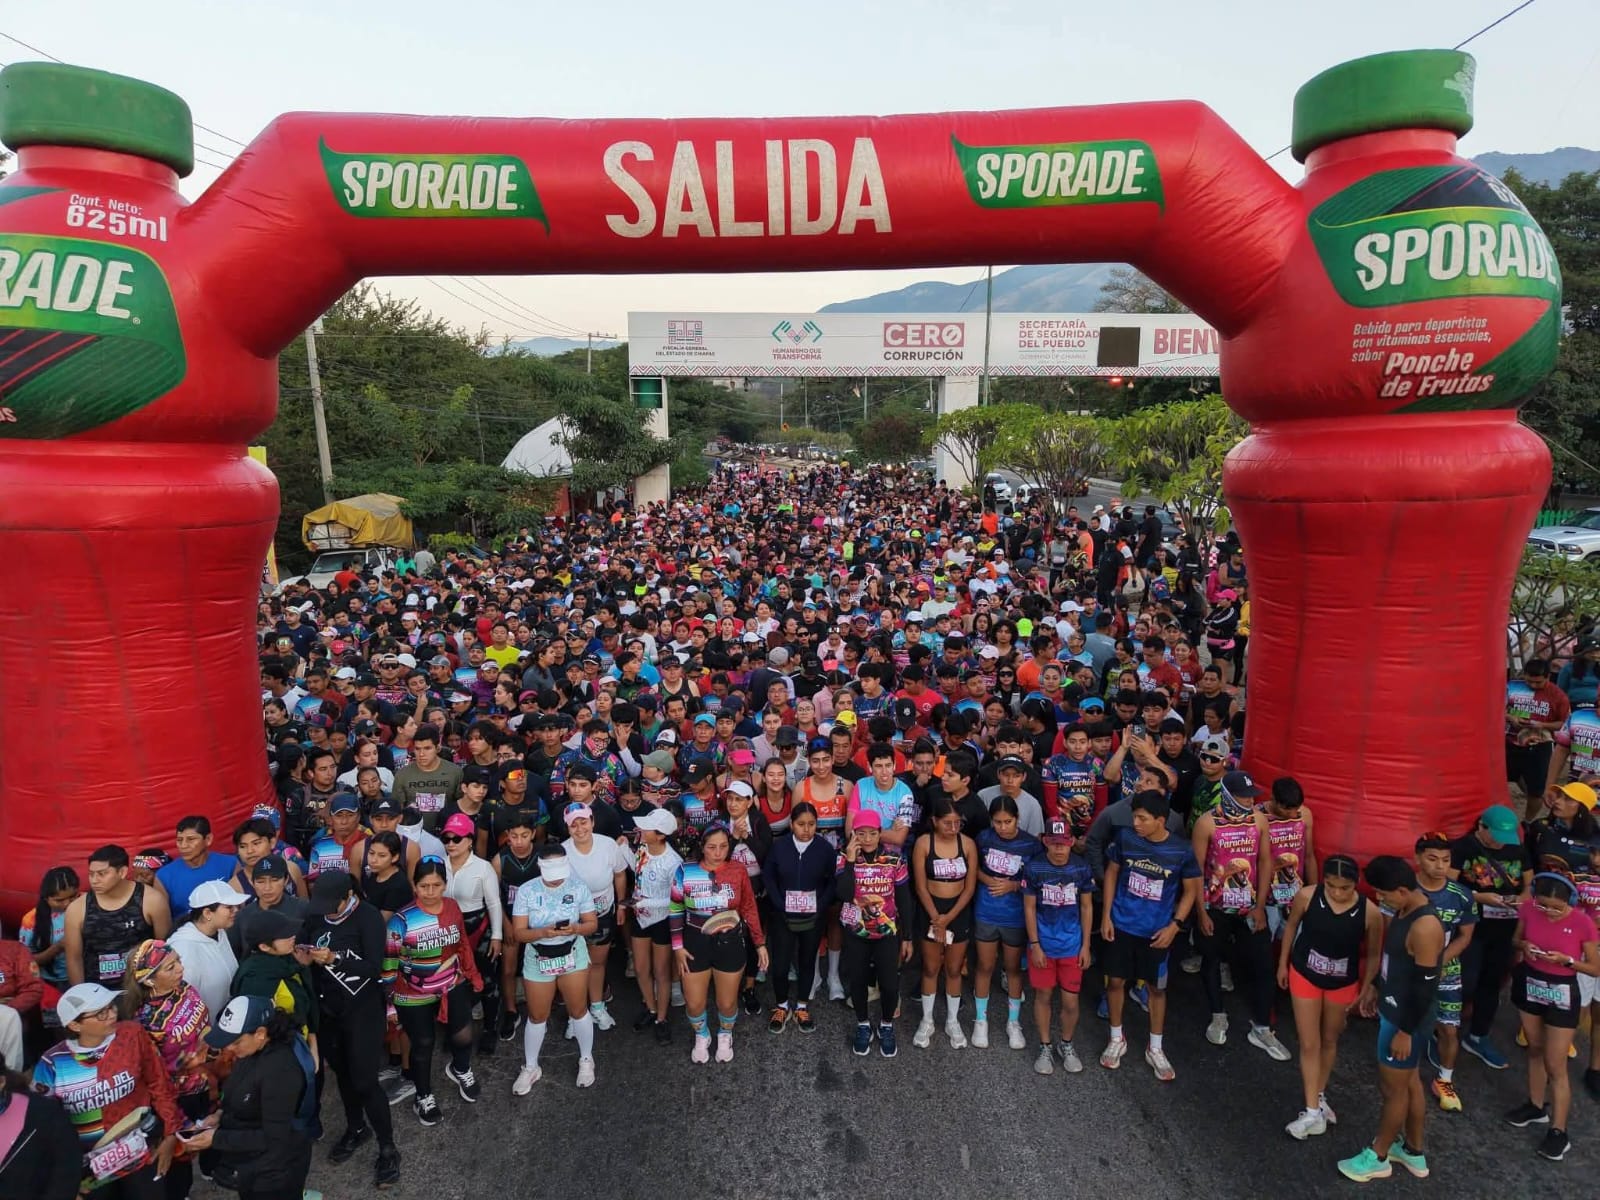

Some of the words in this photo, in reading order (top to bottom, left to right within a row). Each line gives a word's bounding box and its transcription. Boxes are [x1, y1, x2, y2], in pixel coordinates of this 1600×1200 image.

[979, 149, 1145, 199] SPORADE
[342, 161, 518, 211] SPORADE
[603, 137, 892, 238] SALIDA
[108, 199, 142, 216] Neto:
[66, 206, 168, 242] 625ml
[1019, 319, 1087, 329] SECRETARÍA
[1019, 330, 1034, 338] DE
[1037, 330, 1100, 338] SEGURIDAD
[1353, 321, 1391, 336] Bebida
[1394, 324, 1421, 336] para
[1424, 318, 1488, 332] deportistas
[885, 324, 962, 346] CERO
[1019, 340, 1040, 348] DEL
[1043, 340, 1086, 348] PUEBLO
[1352, 338, 1373, 349] con
[1376, 334, 1431, 347] vitaminas
[1434, 331, 1492, 344] esenciales,
[884, 350, 963, 361] CORRUPCIÓN
[1352, 351, 1385, 362] sabor
[1385, 348, 1474, 375] Ponche
[1380, 377, 1412, 398] de
[1416, 374, 1495, 396] Frutas
[409, 780, 449, 788] ROGUE
[62, 1080, 111, 1104] CARRERA
[112, 1071, 135, 1086] DEL
